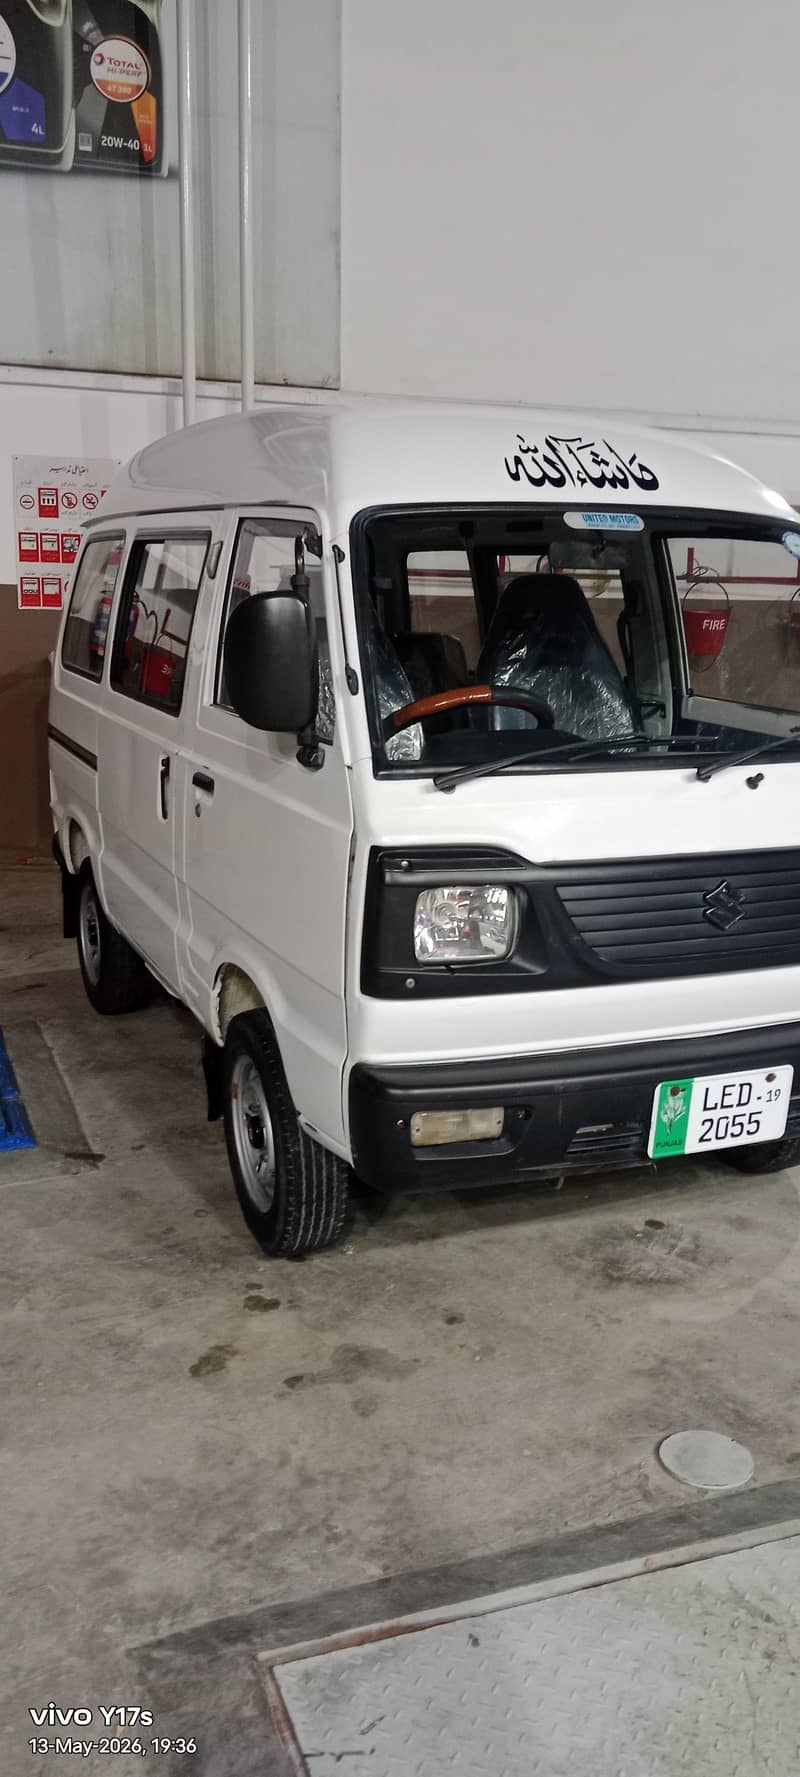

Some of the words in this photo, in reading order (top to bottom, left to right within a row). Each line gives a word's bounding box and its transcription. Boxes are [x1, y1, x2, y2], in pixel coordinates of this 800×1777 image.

[107, 57, 141, 70] TOTAL
[31, 122, 45, 135] 4L
[101, 135, 140, 150] 20W-40
[582, 513, 608, 523] UNITED
[609, 514, 640, 525] MOTORS
[702, 619, 727, 631] FIRE
[702, 1082, 753, 1112] LED
[698, 1110, 763, 1144] 2055
[655, 1139, 682, 1149] PUNJAB
